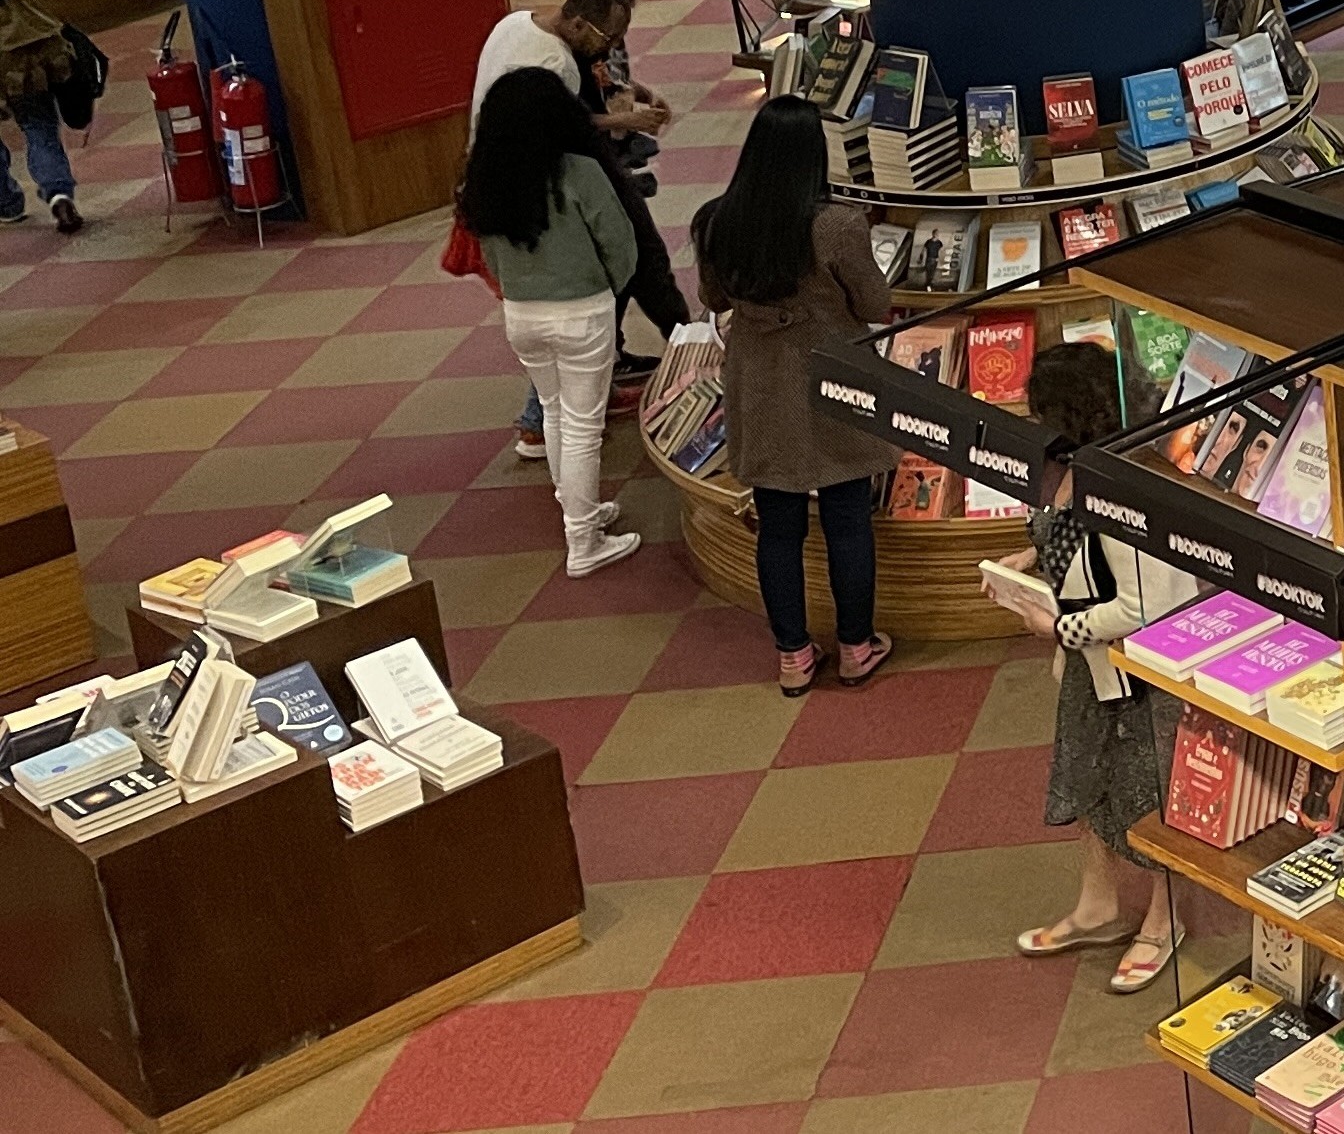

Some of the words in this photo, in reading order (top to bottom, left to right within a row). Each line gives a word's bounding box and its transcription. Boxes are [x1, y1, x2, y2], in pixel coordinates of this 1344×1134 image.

[1186, 54, 1235, 78] COMECE
[1200, 77, 1231, 96] PELO
[1049, 99, 1095, 119] SELVA
[1157, 333, 1179, 345] BOA
[1147, 341, 1182, 357] SORTE
